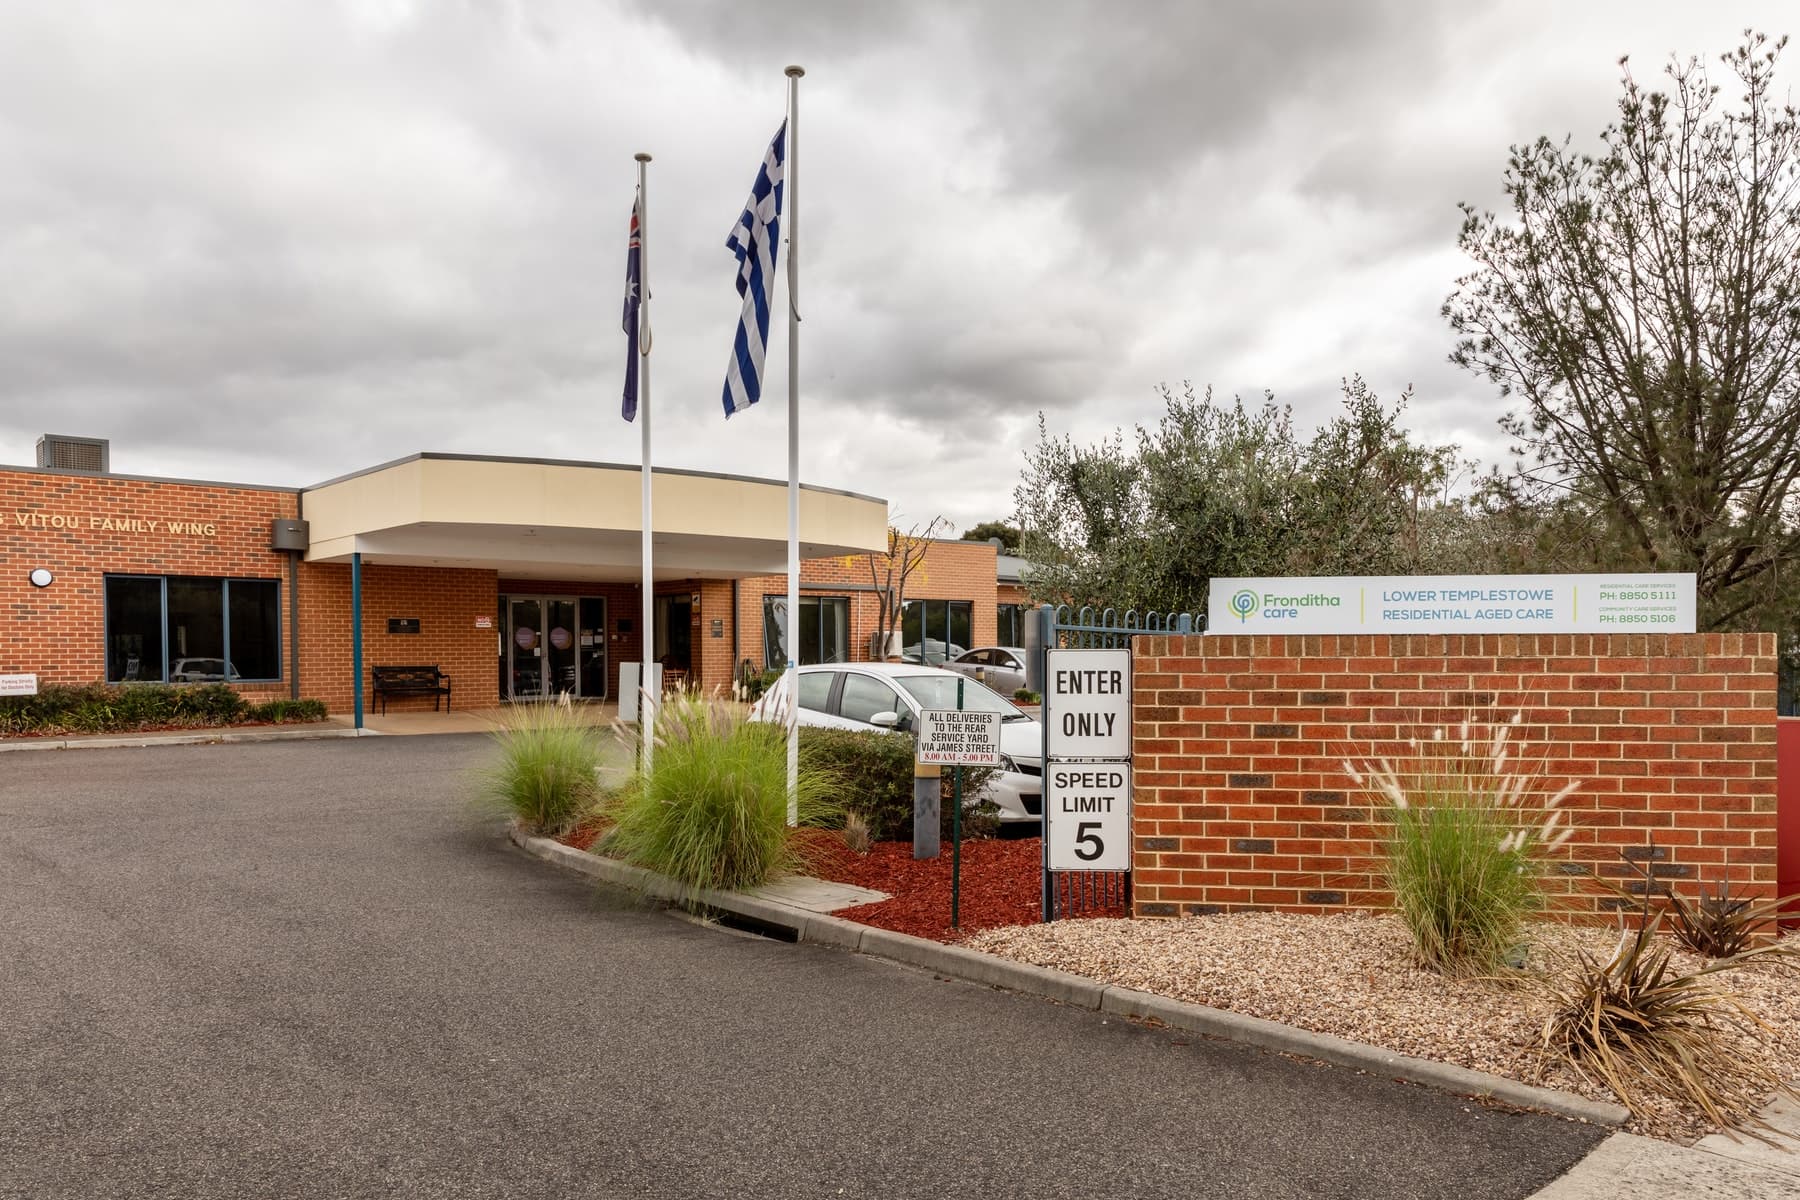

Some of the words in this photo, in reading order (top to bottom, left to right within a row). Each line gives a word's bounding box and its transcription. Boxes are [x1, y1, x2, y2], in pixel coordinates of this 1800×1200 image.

[15, 512, 79, 529] VITOU
[90, 517, 157, 533] FAMILY
[167, 521, 216, 536] WING
[1264, 594, 1340, 606] Fronditha
[1383, 590, 1436, 602] LOWER
[1440, 589, 1554, 601] TEMPLESTOWE
[1600, 592, 1617, 600] PH:
[1620, 592, 1648, 600] 8850
[1650, 592, 1676, 600] 5111
[1264, 608, 1298, 618] care
[1383, 609, 1472, 620] RESIDENTIAL
[1474, 608, 1513, 620] AGED
[1516, 609, 1554, 619] CARE
[1600, 615, 1617, 623] PH:
[1620, 615, 1648, 623] 8850
[1650, 615, 1676, 623] 5106
[1056, 670, 1122, 694] ENTER
[929, 713, 944, 722] ALL
[946, 713, 993, 723] DELIVERIES
[934, 723, 945, 732] TO
[948, 724, 963, 733] THE
[964, 724, 986, 733] REAR
[1063, 713, 1116, 737] ONLY
[931, 733, 965, 743] SERVICE
[967, 734, 989, 743] YARD
[921, 742, 935, 752] VIA
[936, 743, 963, 753] JAMES
[924, 752, 940, 760] 8.00
[962, 753, 978, 761] 5.00
[980, 754, 993, 762] PM
[1055, 772, 1123, 789] SPEED
[1062, 797, 1115, 813] LIMIT
[1073, 821, 1105, 861] 5
